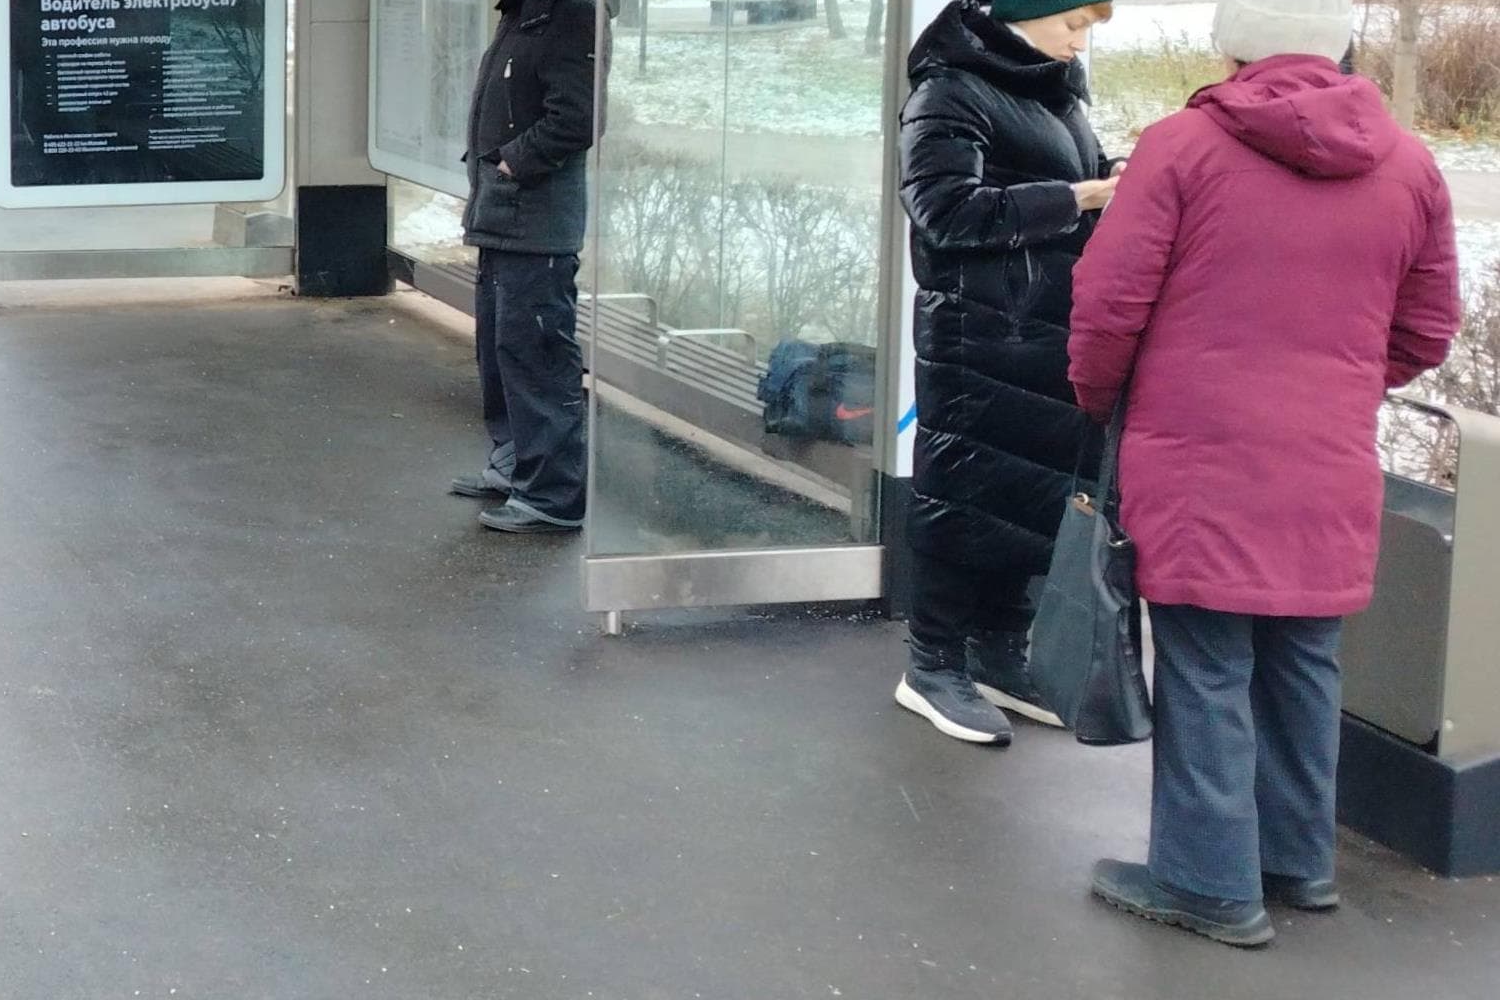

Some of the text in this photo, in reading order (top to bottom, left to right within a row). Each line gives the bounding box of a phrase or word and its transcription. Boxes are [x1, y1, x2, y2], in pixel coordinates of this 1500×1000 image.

[41, 14, 115, 33] автобуса
[41, 34, 172, 48] Эта профессия нужна городу
